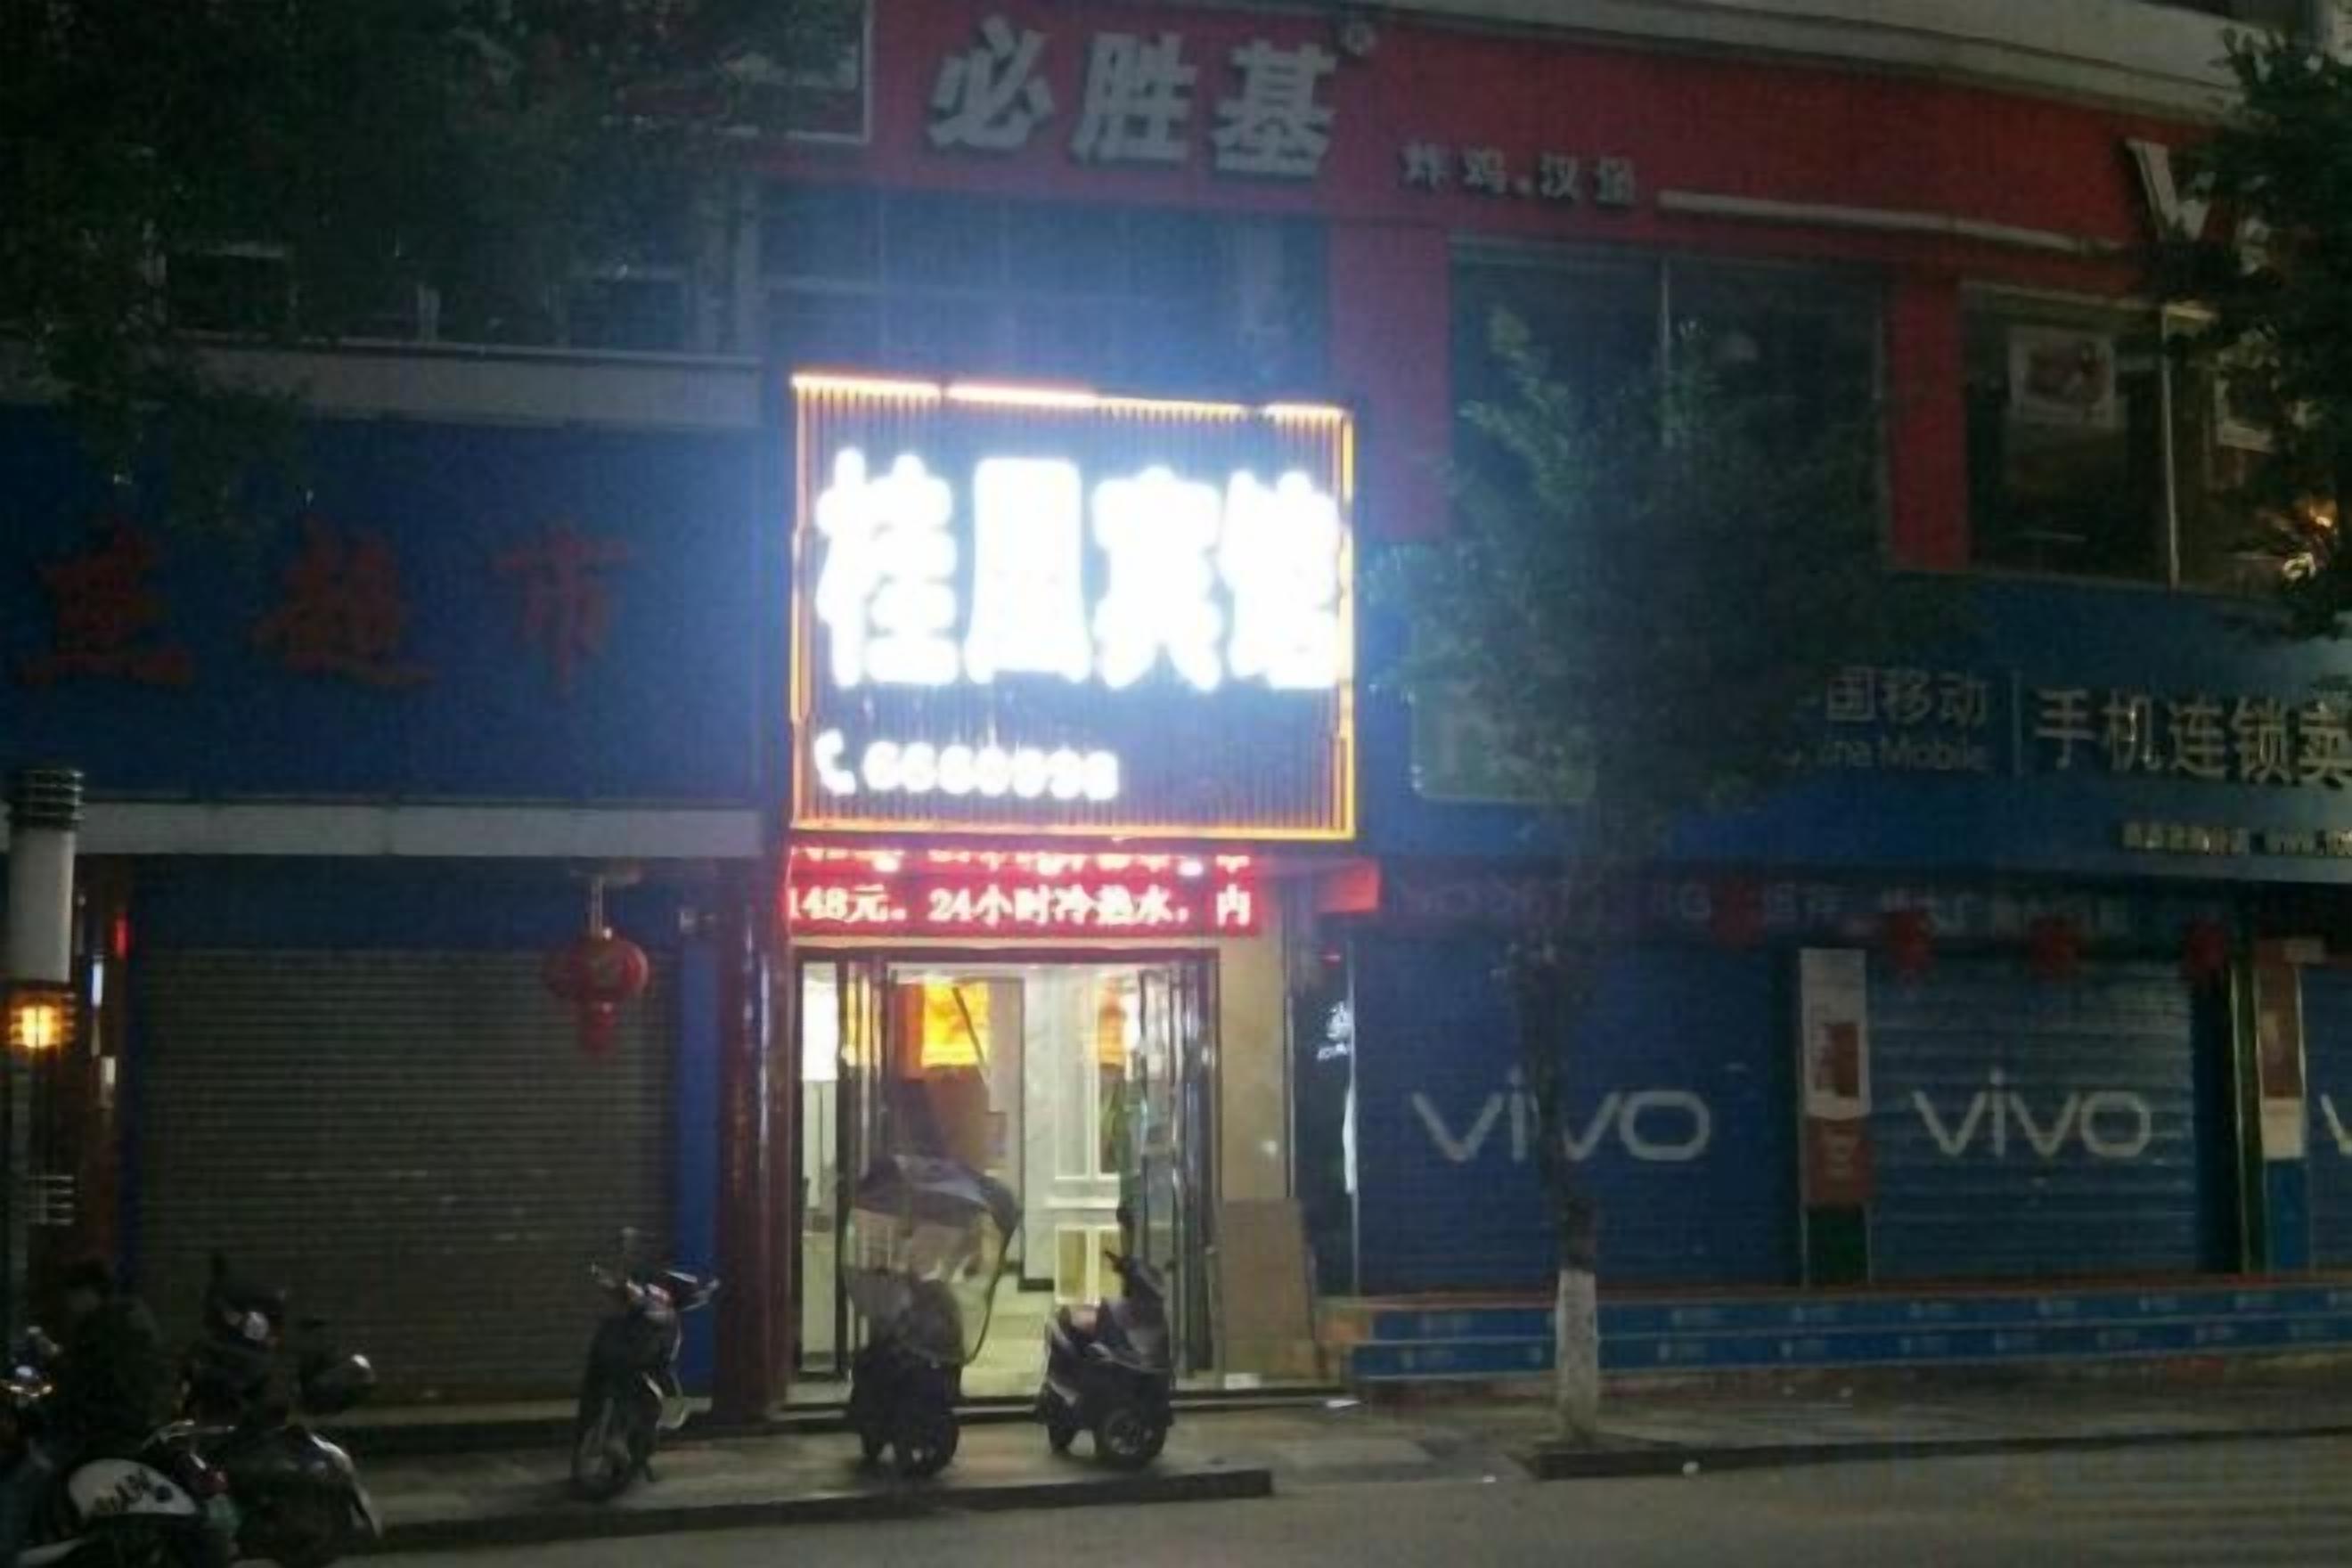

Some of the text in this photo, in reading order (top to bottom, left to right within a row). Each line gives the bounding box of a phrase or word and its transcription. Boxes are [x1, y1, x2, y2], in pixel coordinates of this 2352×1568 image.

[928, 13, 1336, 176] 必胜基
[1793, 665, 1990, 728] 国移动
[1410, 1062, 1711, 1163] vivo
[1912, 1068, 2152, 1161] vivo
